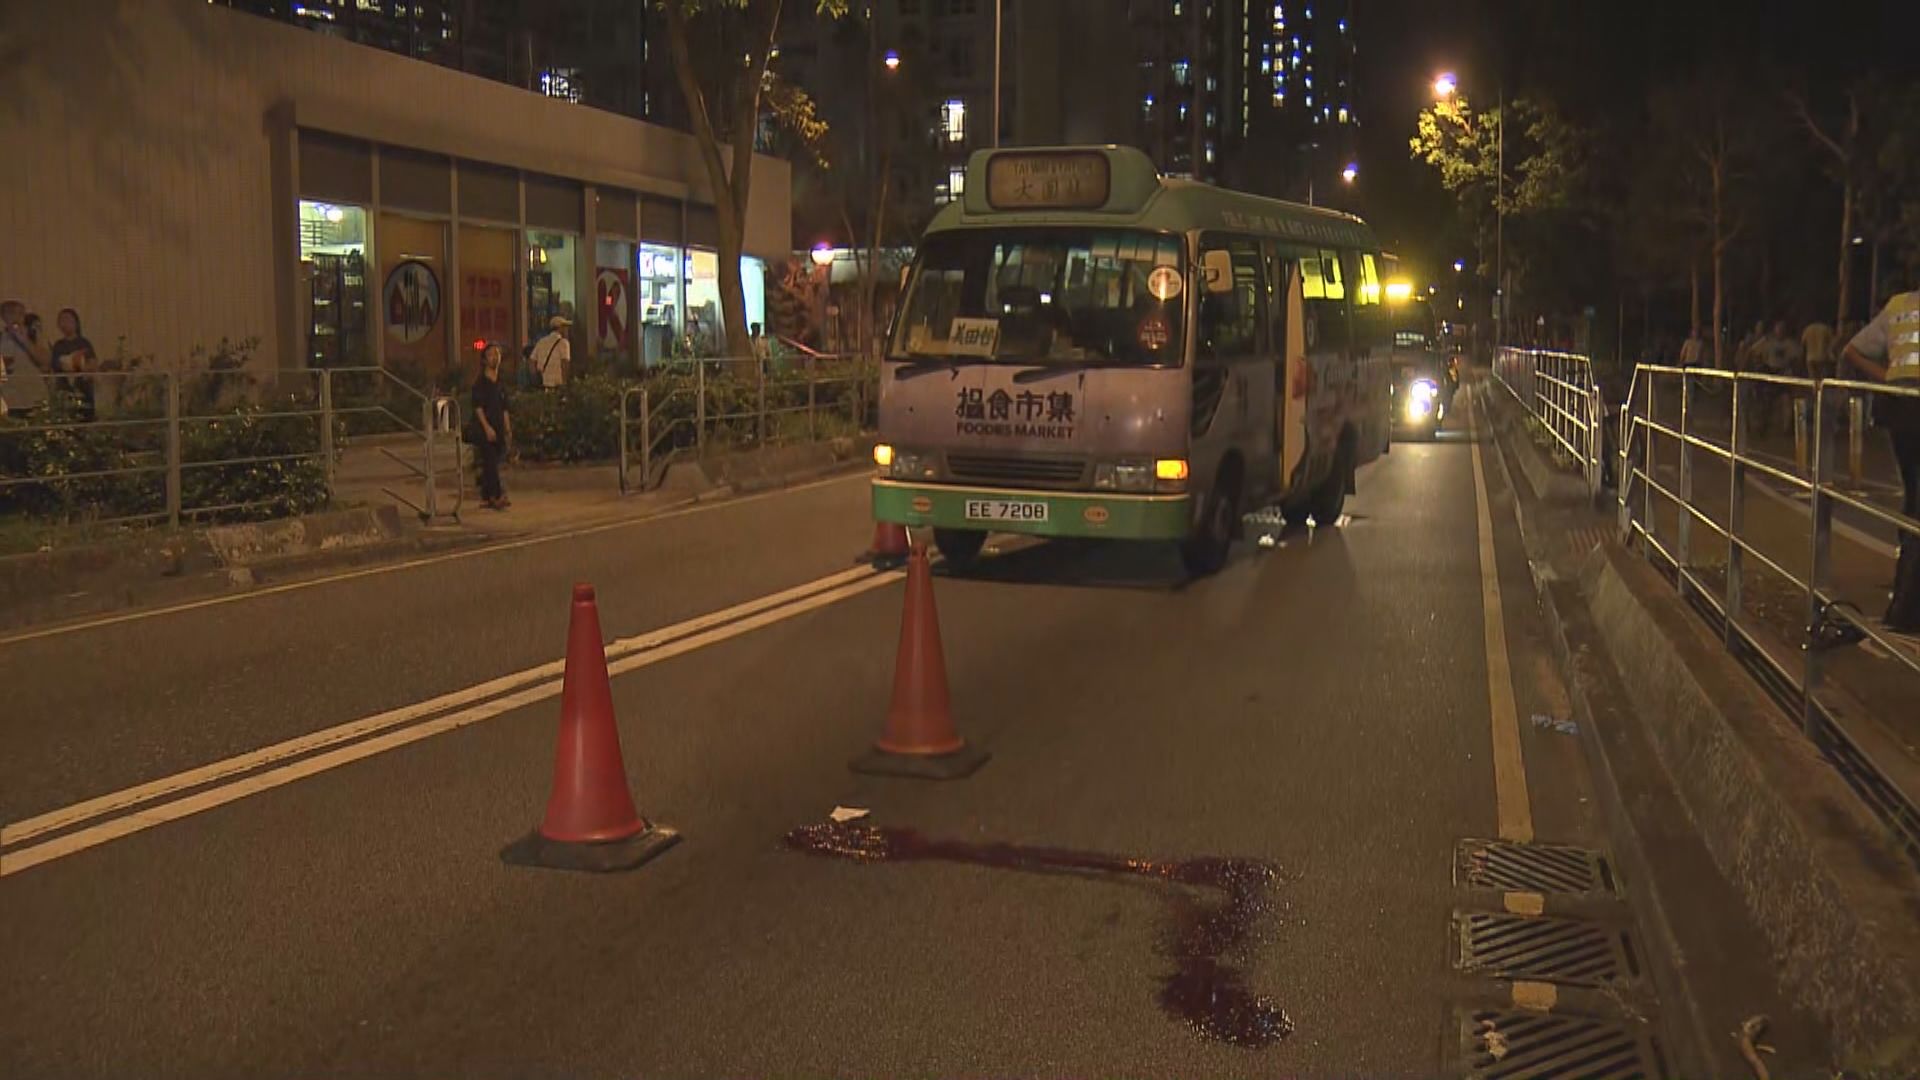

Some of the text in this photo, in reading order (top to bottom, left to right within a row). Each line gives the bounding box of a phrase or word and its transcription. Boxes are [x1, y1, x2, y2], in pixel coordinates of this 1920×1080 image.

[956, 422, 1074, 439] FOODIES MARKET
[968, 502, 1045, 519] EE 7208
